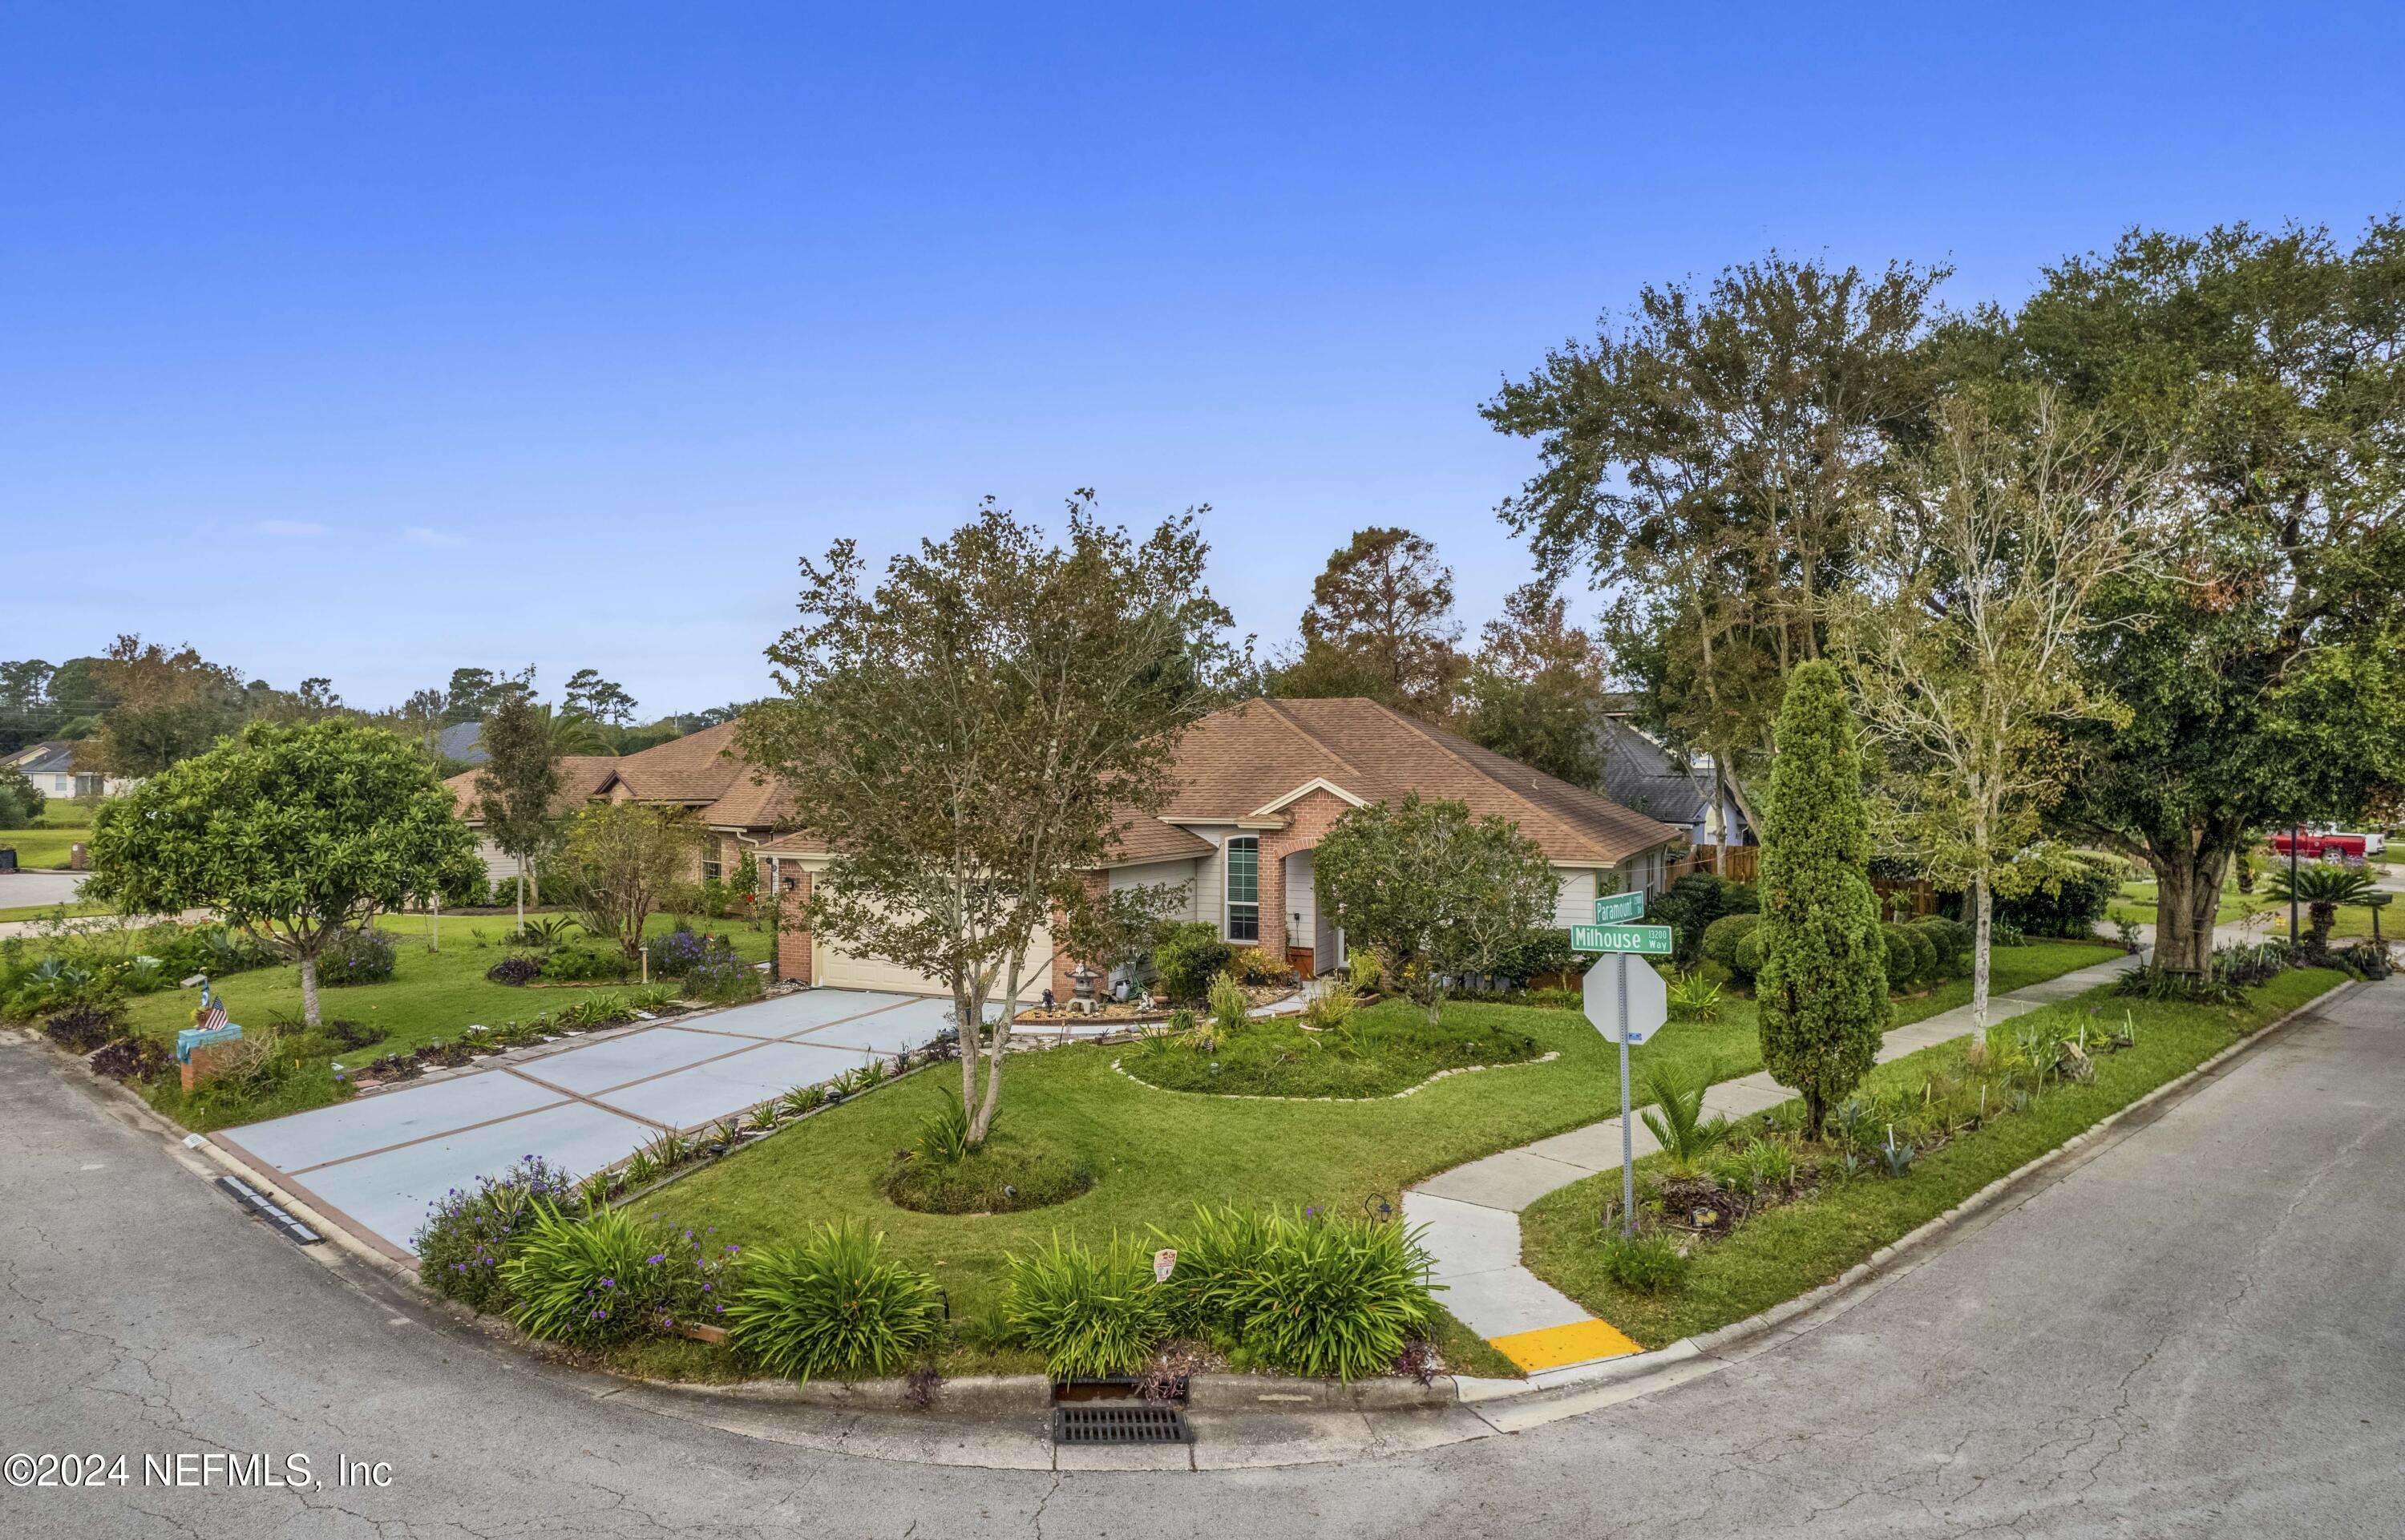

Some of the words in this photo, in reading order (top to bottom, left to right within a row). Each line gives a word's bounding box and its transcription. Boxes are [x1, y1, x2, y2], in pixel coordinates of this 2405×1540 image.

[1597, 899, 1632, 921] Paramount
[1575, 927, 1641, 948] Milhouse
[1648, 930, 1667, 939] 13200
[1648, 940, 1667, 951] Way
